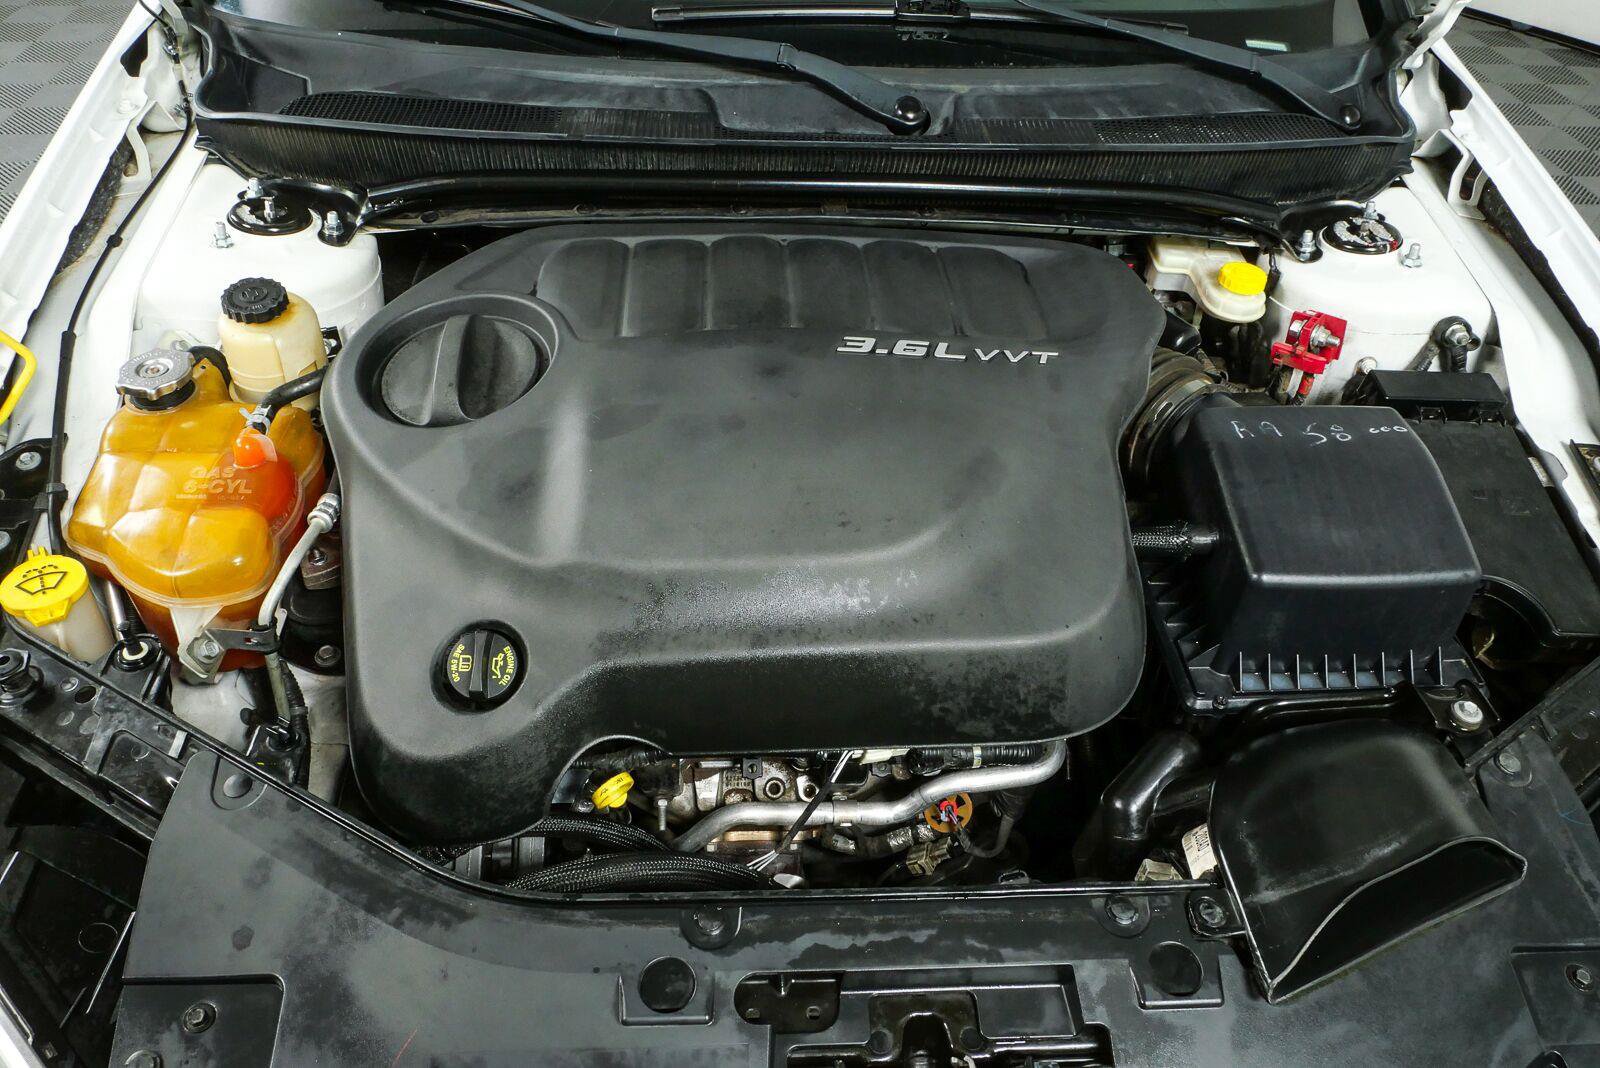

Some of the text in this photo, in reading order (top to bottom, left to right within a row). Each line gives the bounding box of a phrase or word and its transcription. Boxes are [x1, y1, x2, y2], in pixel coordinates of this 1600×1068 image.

[836, 336, 1059, 364] 3.6L VVT
[190, 466, 235, 478] GAS
[183, 479, 252, 494] 6-CYL
[450, 644, 465, 682] SAE 5W-20
[499, 645, 515, 686] ENGINE OIL
